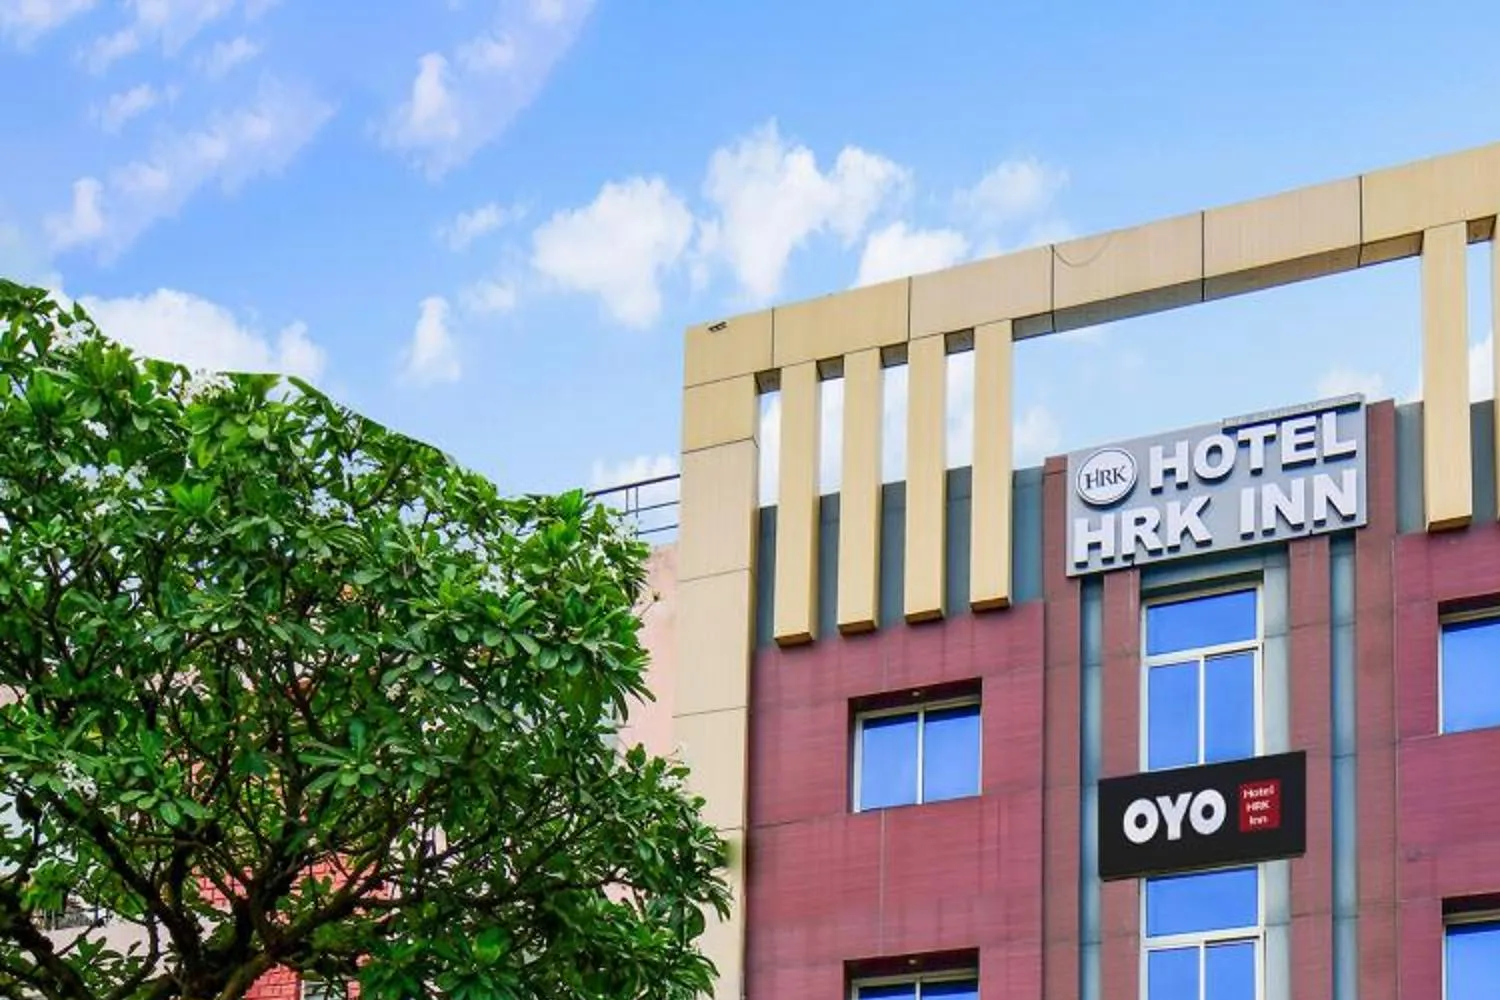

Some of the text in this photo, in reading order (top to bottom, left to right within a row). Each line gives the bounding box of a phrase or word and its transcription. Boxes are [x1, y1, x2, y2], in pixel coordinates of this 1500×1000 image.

[1150, 411, 1357, 492] HOTEL
[1084, 465, 1126, 489] HRK
[1073, 468, 1357, 566] HRK INN
[1243, 785, 1275, 799] Hotel
[1246, 800, 1271, 813] HRK
[1123, 789, 1226, 844] OYO
